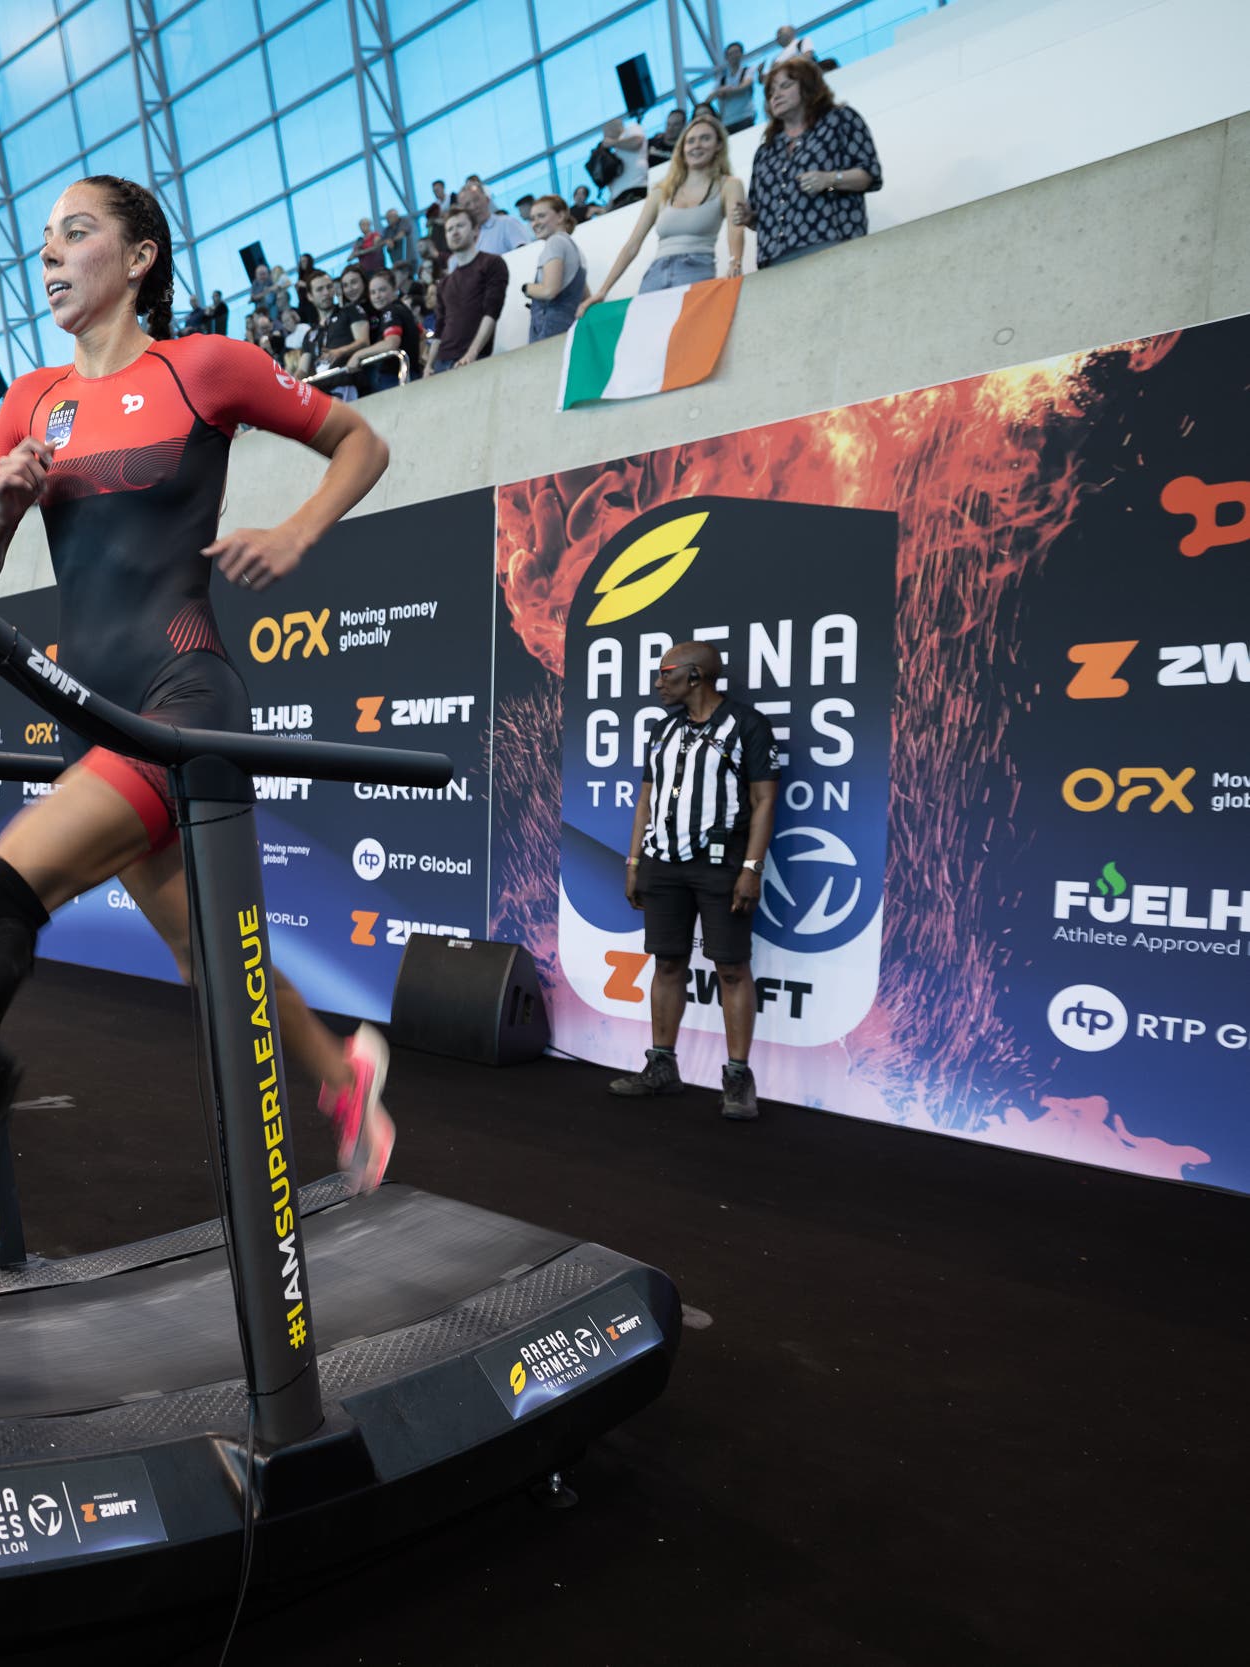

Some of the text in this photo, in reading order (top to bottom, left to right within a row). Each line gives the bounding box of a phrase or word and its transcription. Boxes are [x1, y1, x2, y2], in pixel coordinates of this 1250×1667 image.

[249, 601, 438, 663] OFX Moving money
[339, 626, 391, 652] globally
[27, 647, 91, 706] ZWIFT
[391, 695, 475, 726] ZWIFT
[24, 722, 54, 745] OFX
[586, 697, 855, 767] GAES
[1062, 767, 1196, 814] OFX
[263, 843, 310, 857] Moving money
[263, 854, 288, 866] globally
[388, 853, 417, 871] RTP
[419, 855, 471, 875] Global
[1053, 925, 1242, 956] Athlete Approved
[1136, 1013, 1207, 1044] RTP
[238, 904, 307, 1350] #IAMSUPERLEAGUE
[520, 1330, 570, 1365] ARENA
[616, 1315, 642, 1334] ZWIFT
[531, 1347, 581, 1382] GAMES
[542, 1363, 588, 1392] TRIATHLON
[99, 1500, 137, 1518] ZWIFT
